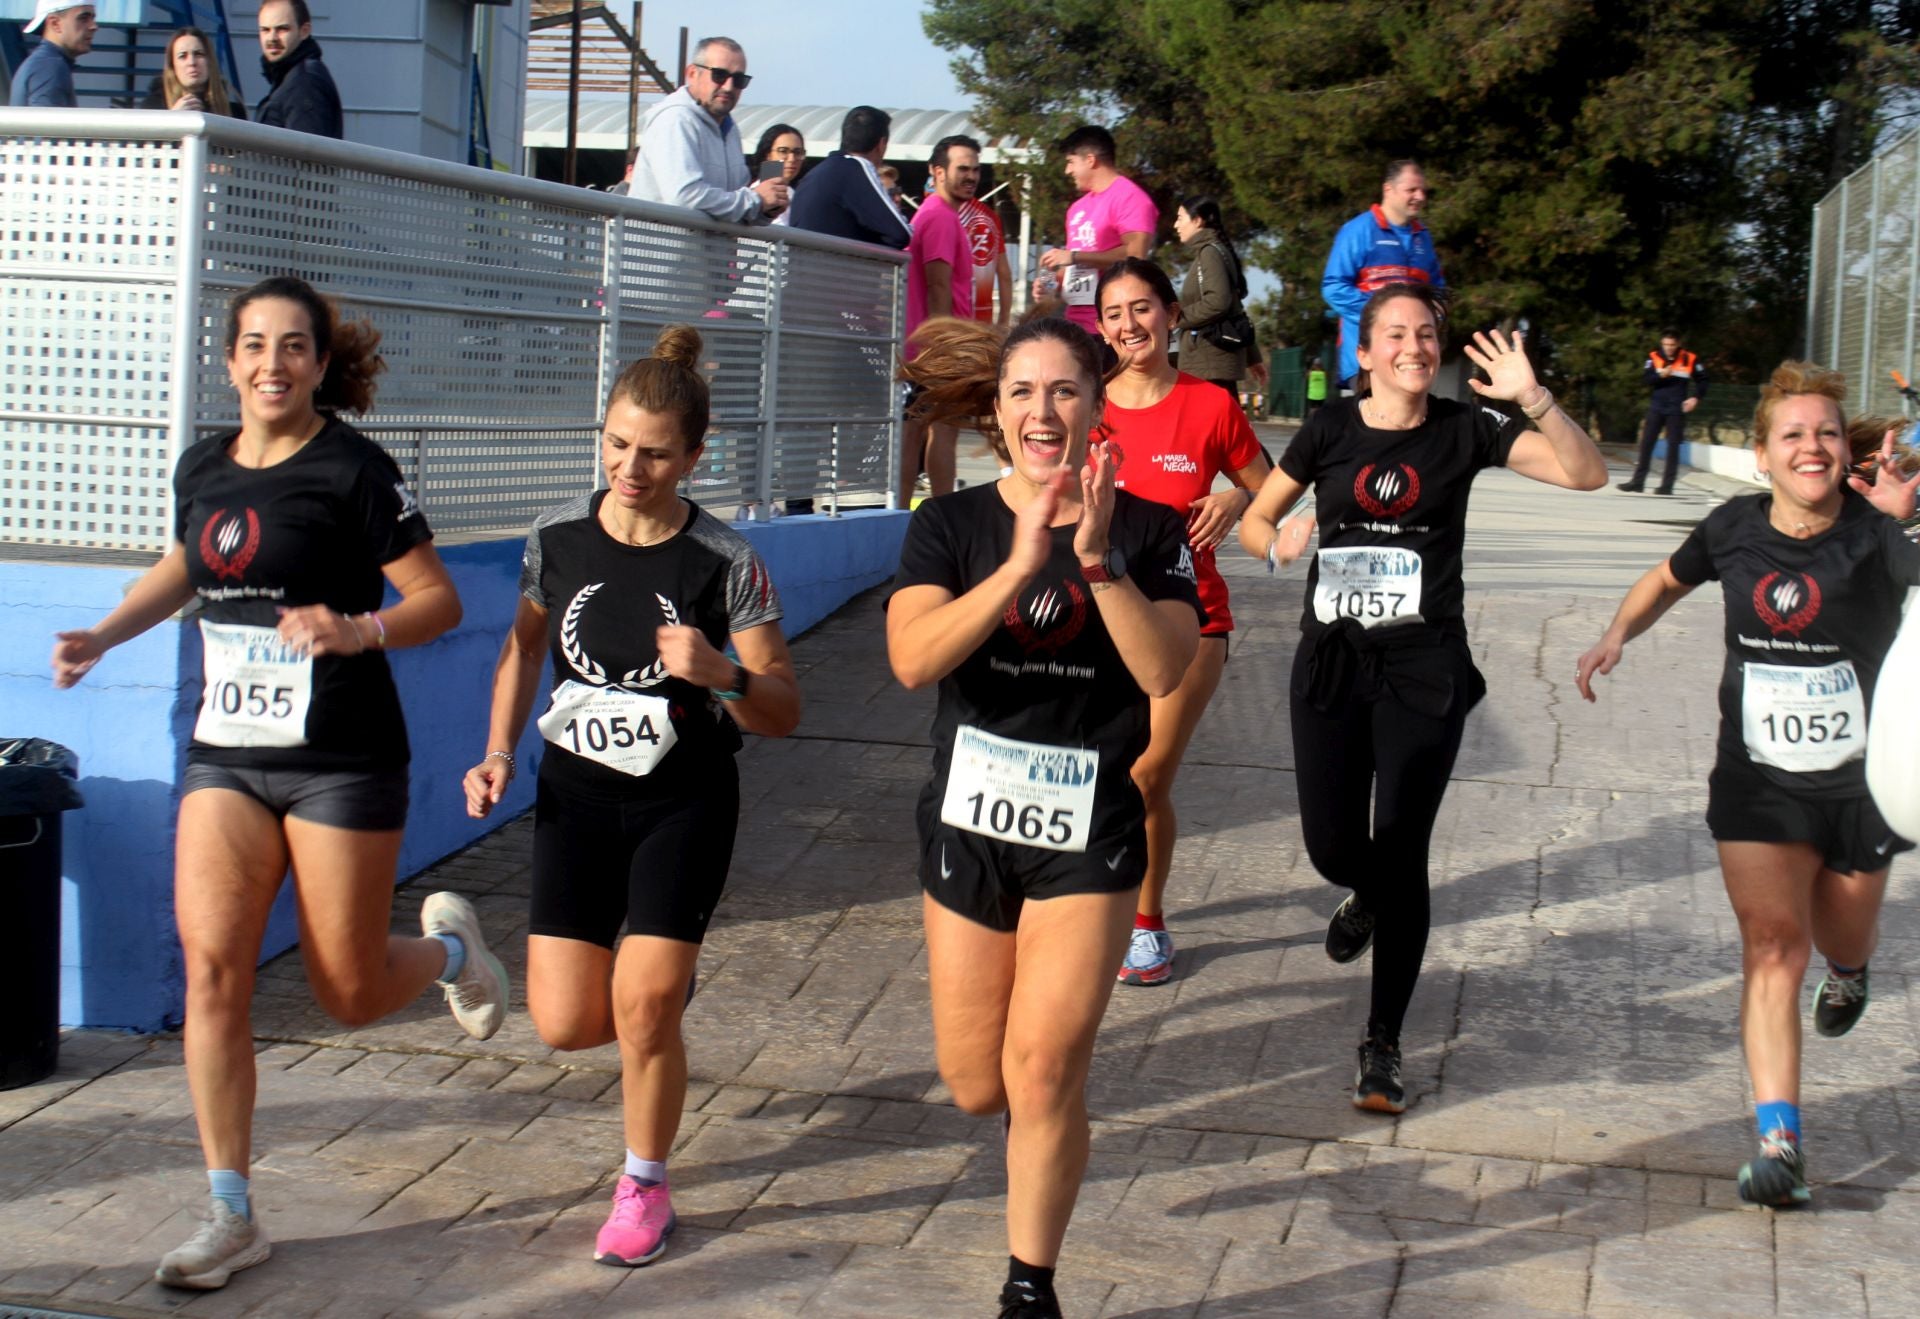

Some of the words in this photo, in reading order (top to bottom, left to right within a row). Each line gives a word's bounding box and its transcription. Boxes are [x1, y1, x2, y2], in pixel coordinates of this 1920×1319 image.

[1151, 454, 1163, 463] LA
[1164, 453, 1188, 463] MAREA
[1163, 461, 1197, 473] NEGRA
[1330, 590, 1407, 619] 1057
[211, 677, 294, 719] 1055
[564, 713, 661, 753] 1054
[1762, 711, 1852, 744] 1052
[967, 791, 1074, 844] 1065
